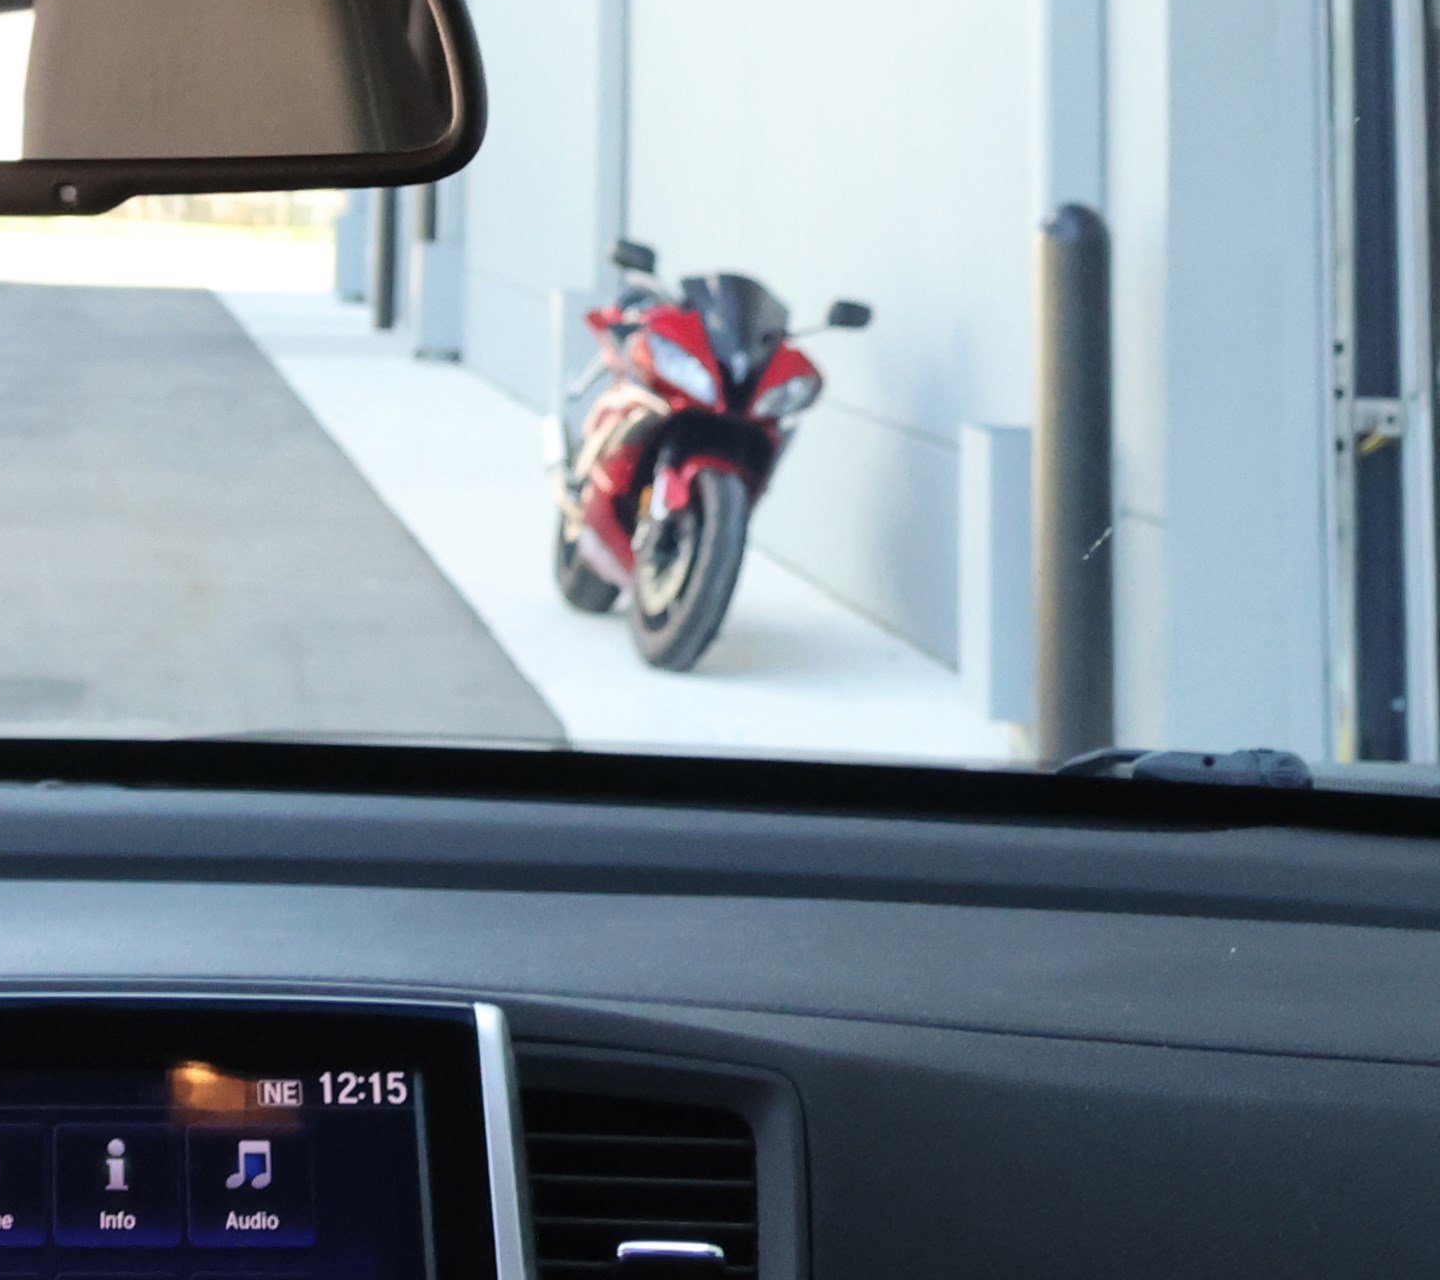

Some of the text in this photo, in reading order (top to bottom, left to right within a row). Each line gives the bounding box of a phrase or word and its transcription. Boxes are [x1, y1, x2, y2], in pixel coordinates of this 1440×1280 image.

[263, 1083, 300, 1104] NE
[319, 1071, 408, 1105] 12:15
[99, 1210, 136, 1230] Info
[225, 1211, 280, 1230] Audio
